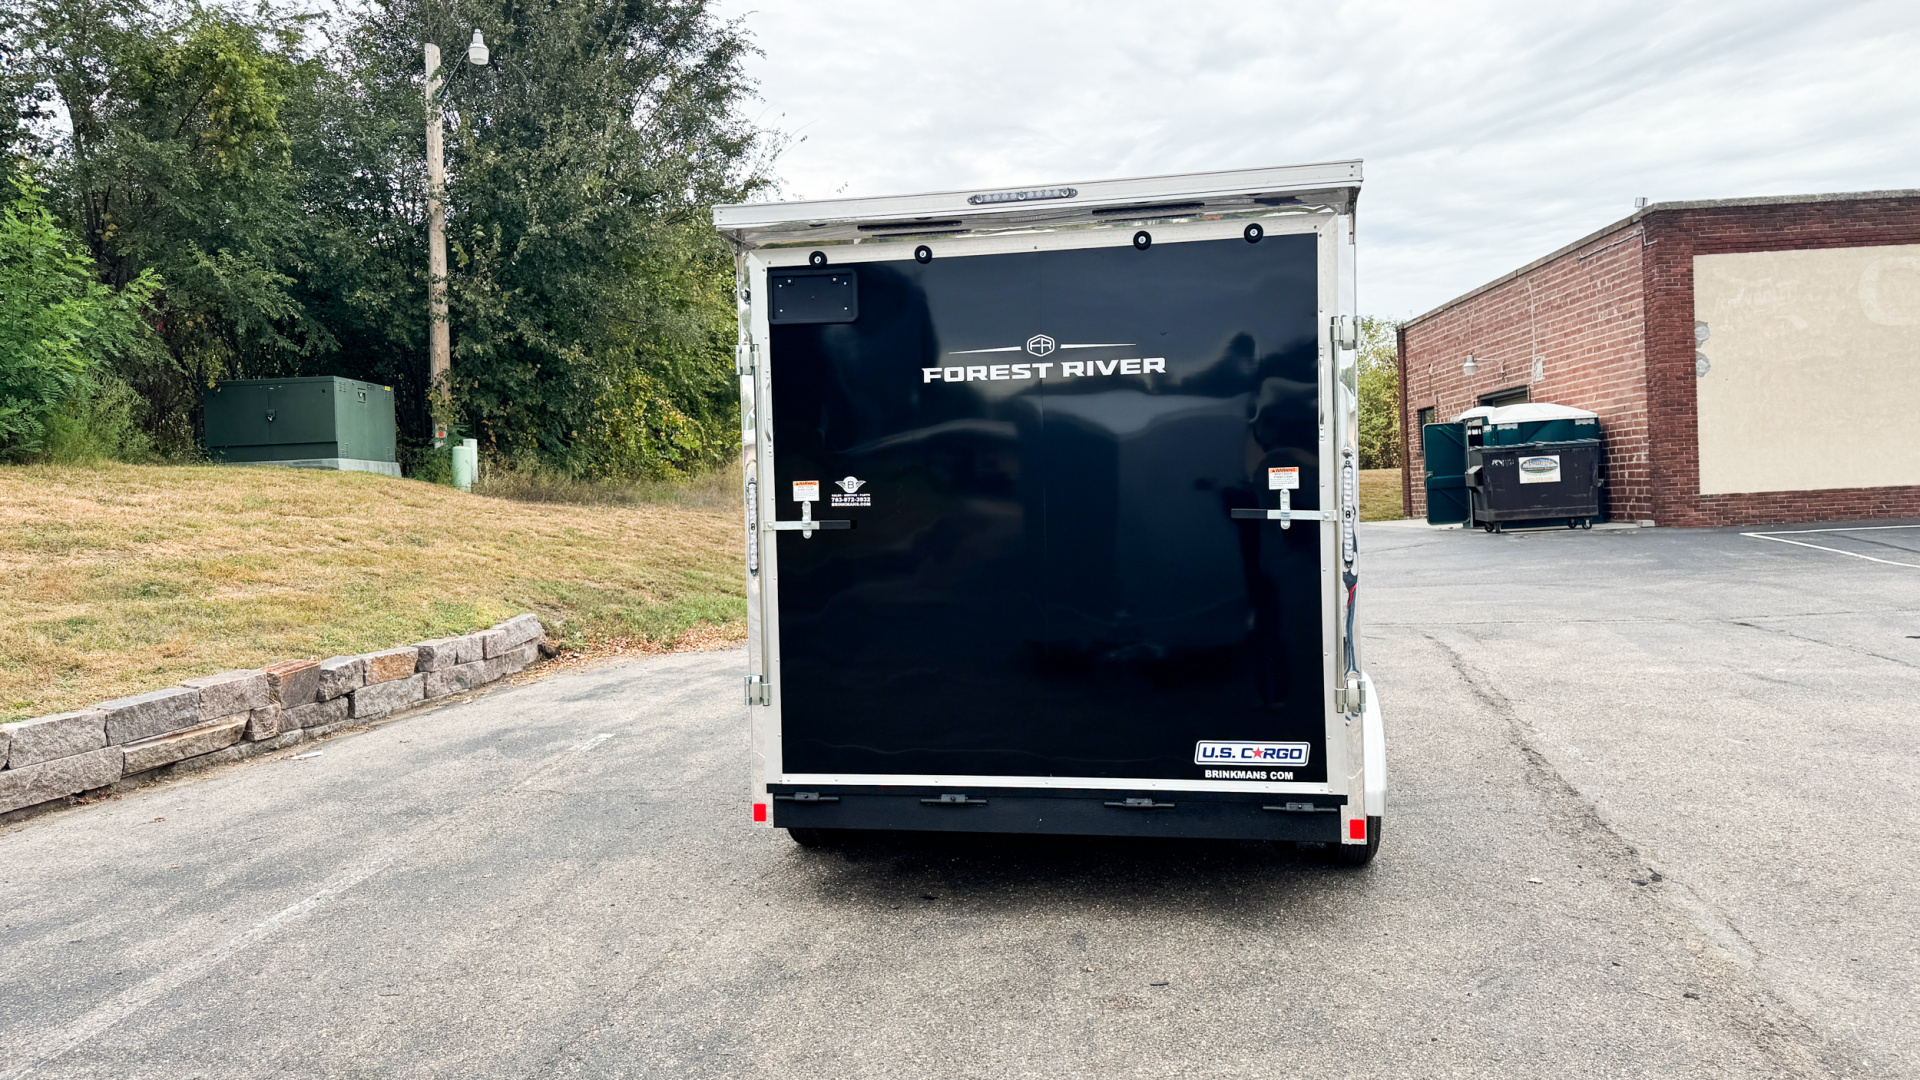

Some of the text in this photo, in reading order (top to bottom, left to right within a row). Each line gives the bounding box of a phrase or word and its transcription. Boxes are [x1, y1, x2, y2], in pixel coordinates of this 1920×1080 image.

[921, 357, 1167, 384] FOREST RIVER
[1202, 747, 1236, 758] U.S.
[1204, 769, 1294, 780] BRINKMANS COM
